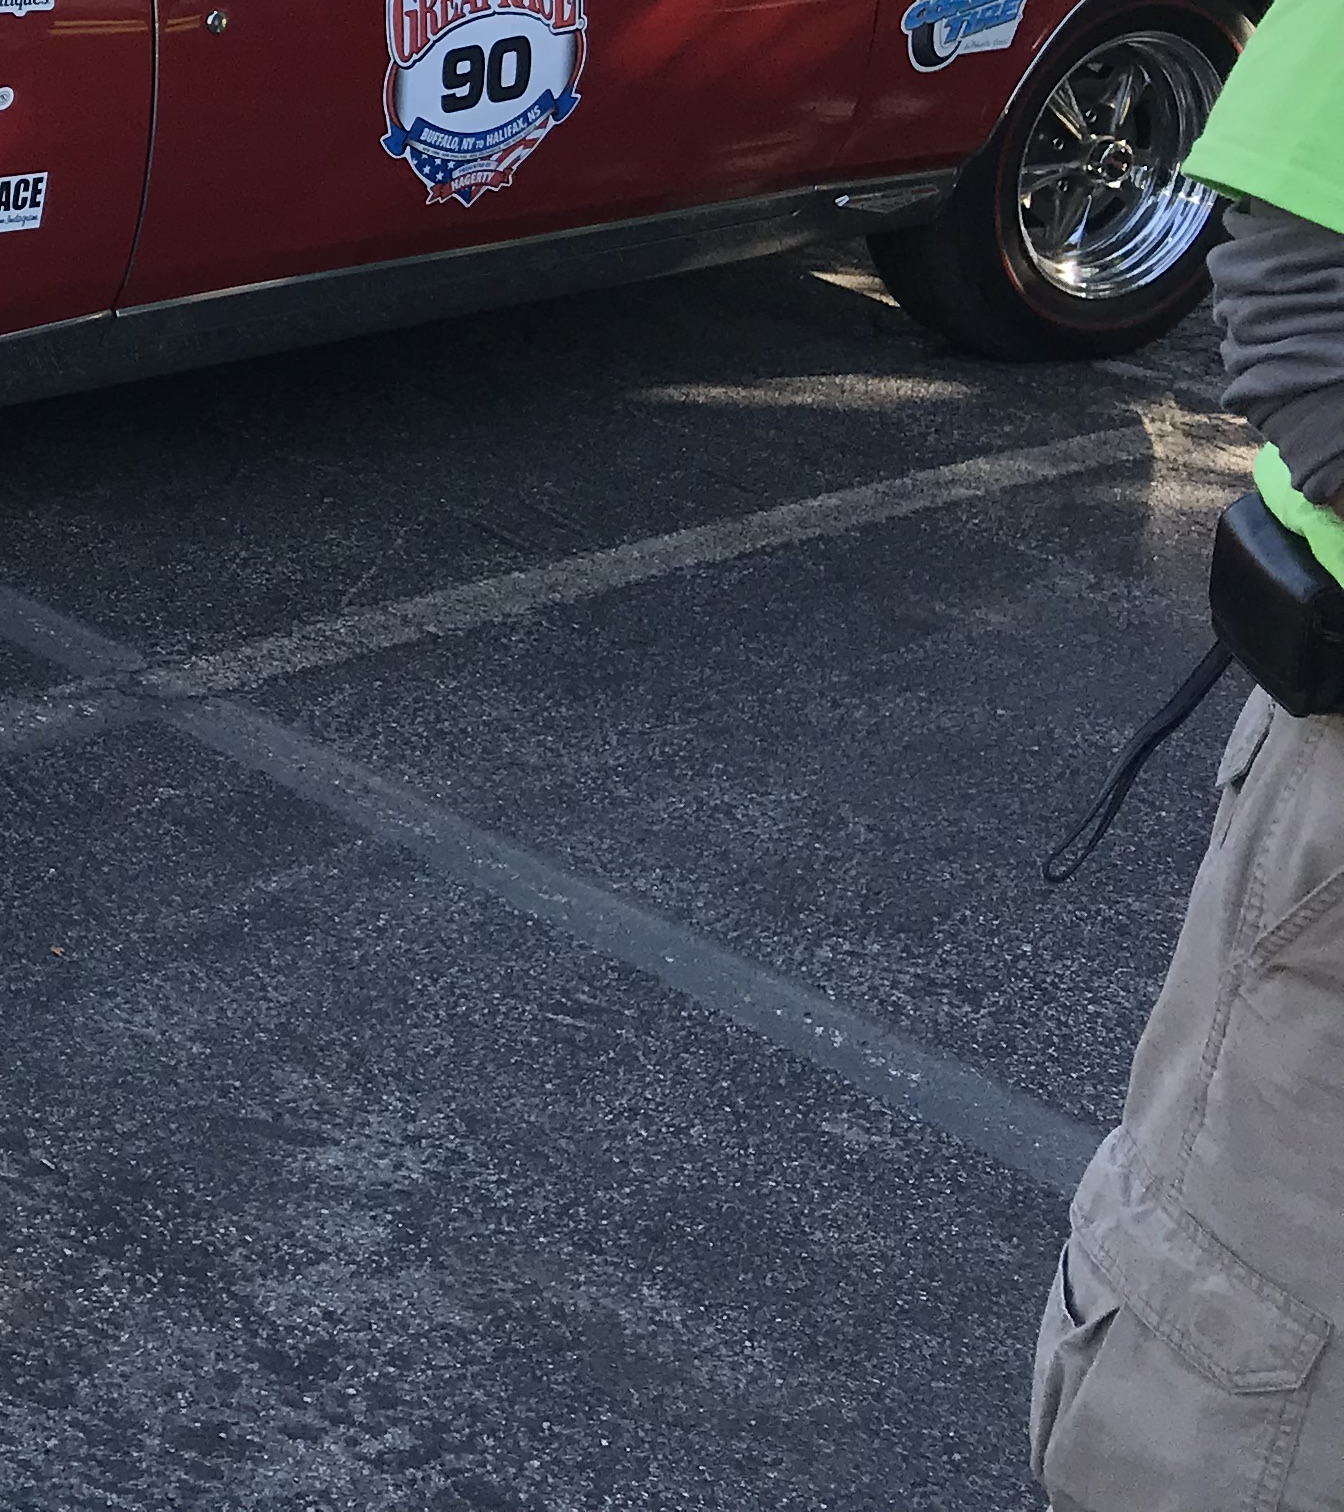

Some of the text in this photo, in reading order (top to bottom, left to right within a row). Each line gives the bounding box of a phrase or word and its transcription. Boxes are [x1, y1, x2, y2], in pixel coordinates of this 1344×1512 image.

[440, 35, 532, 114] 90
[420, 127, 459, 151] BUFFALO,
[460, 137, 477, 151] NY
[486, 118, 528, 146] HALIFAX,
[527, 104, 541, 122] NS
[450, 171, 495, 190] HAGERTY
